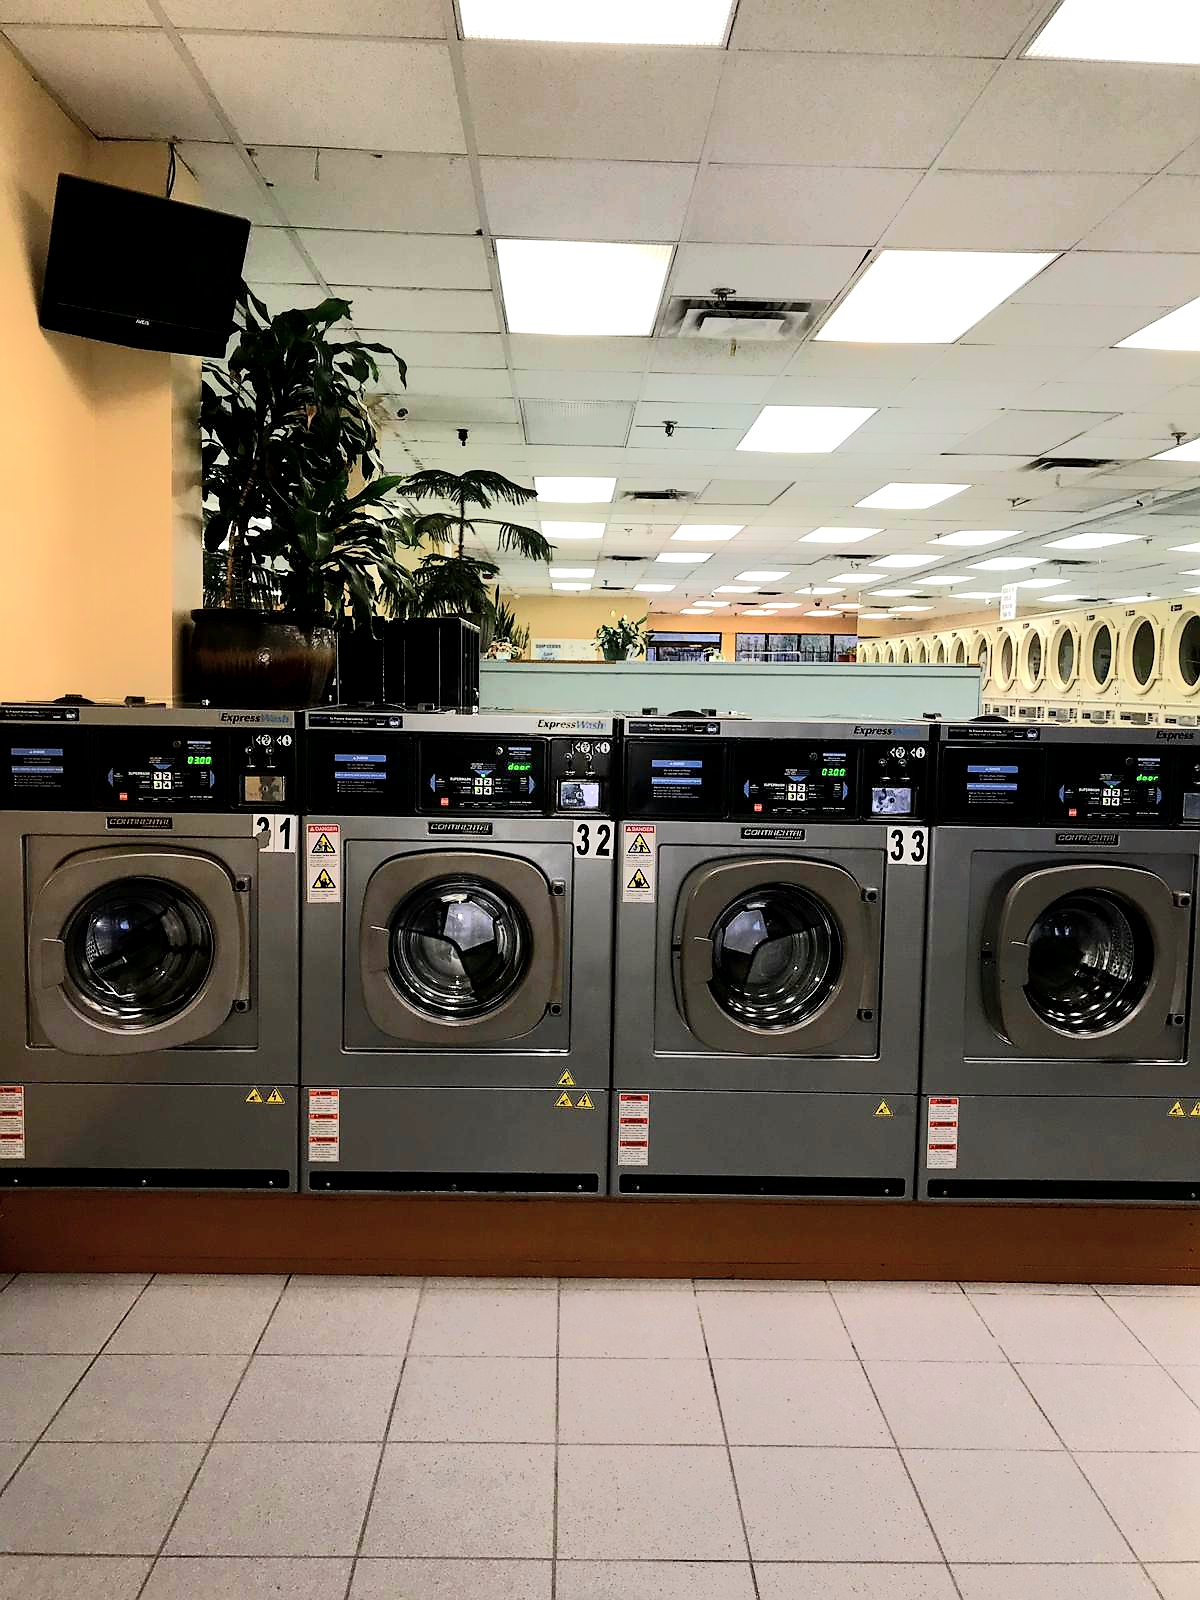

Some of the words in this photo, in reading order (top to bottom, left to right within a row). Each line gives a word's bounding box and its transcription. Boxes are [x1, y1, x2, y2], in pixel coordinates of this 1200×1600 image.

[537, 719, 605, 731] ExpressWash
[507, 762, 531, 771] door
[1136, 773, 1159, 782] door
[743, 829, 803, 837] CONTINENTAL
[576, 823, 611, 857] 32
[890, 829, 925, 862] 33
